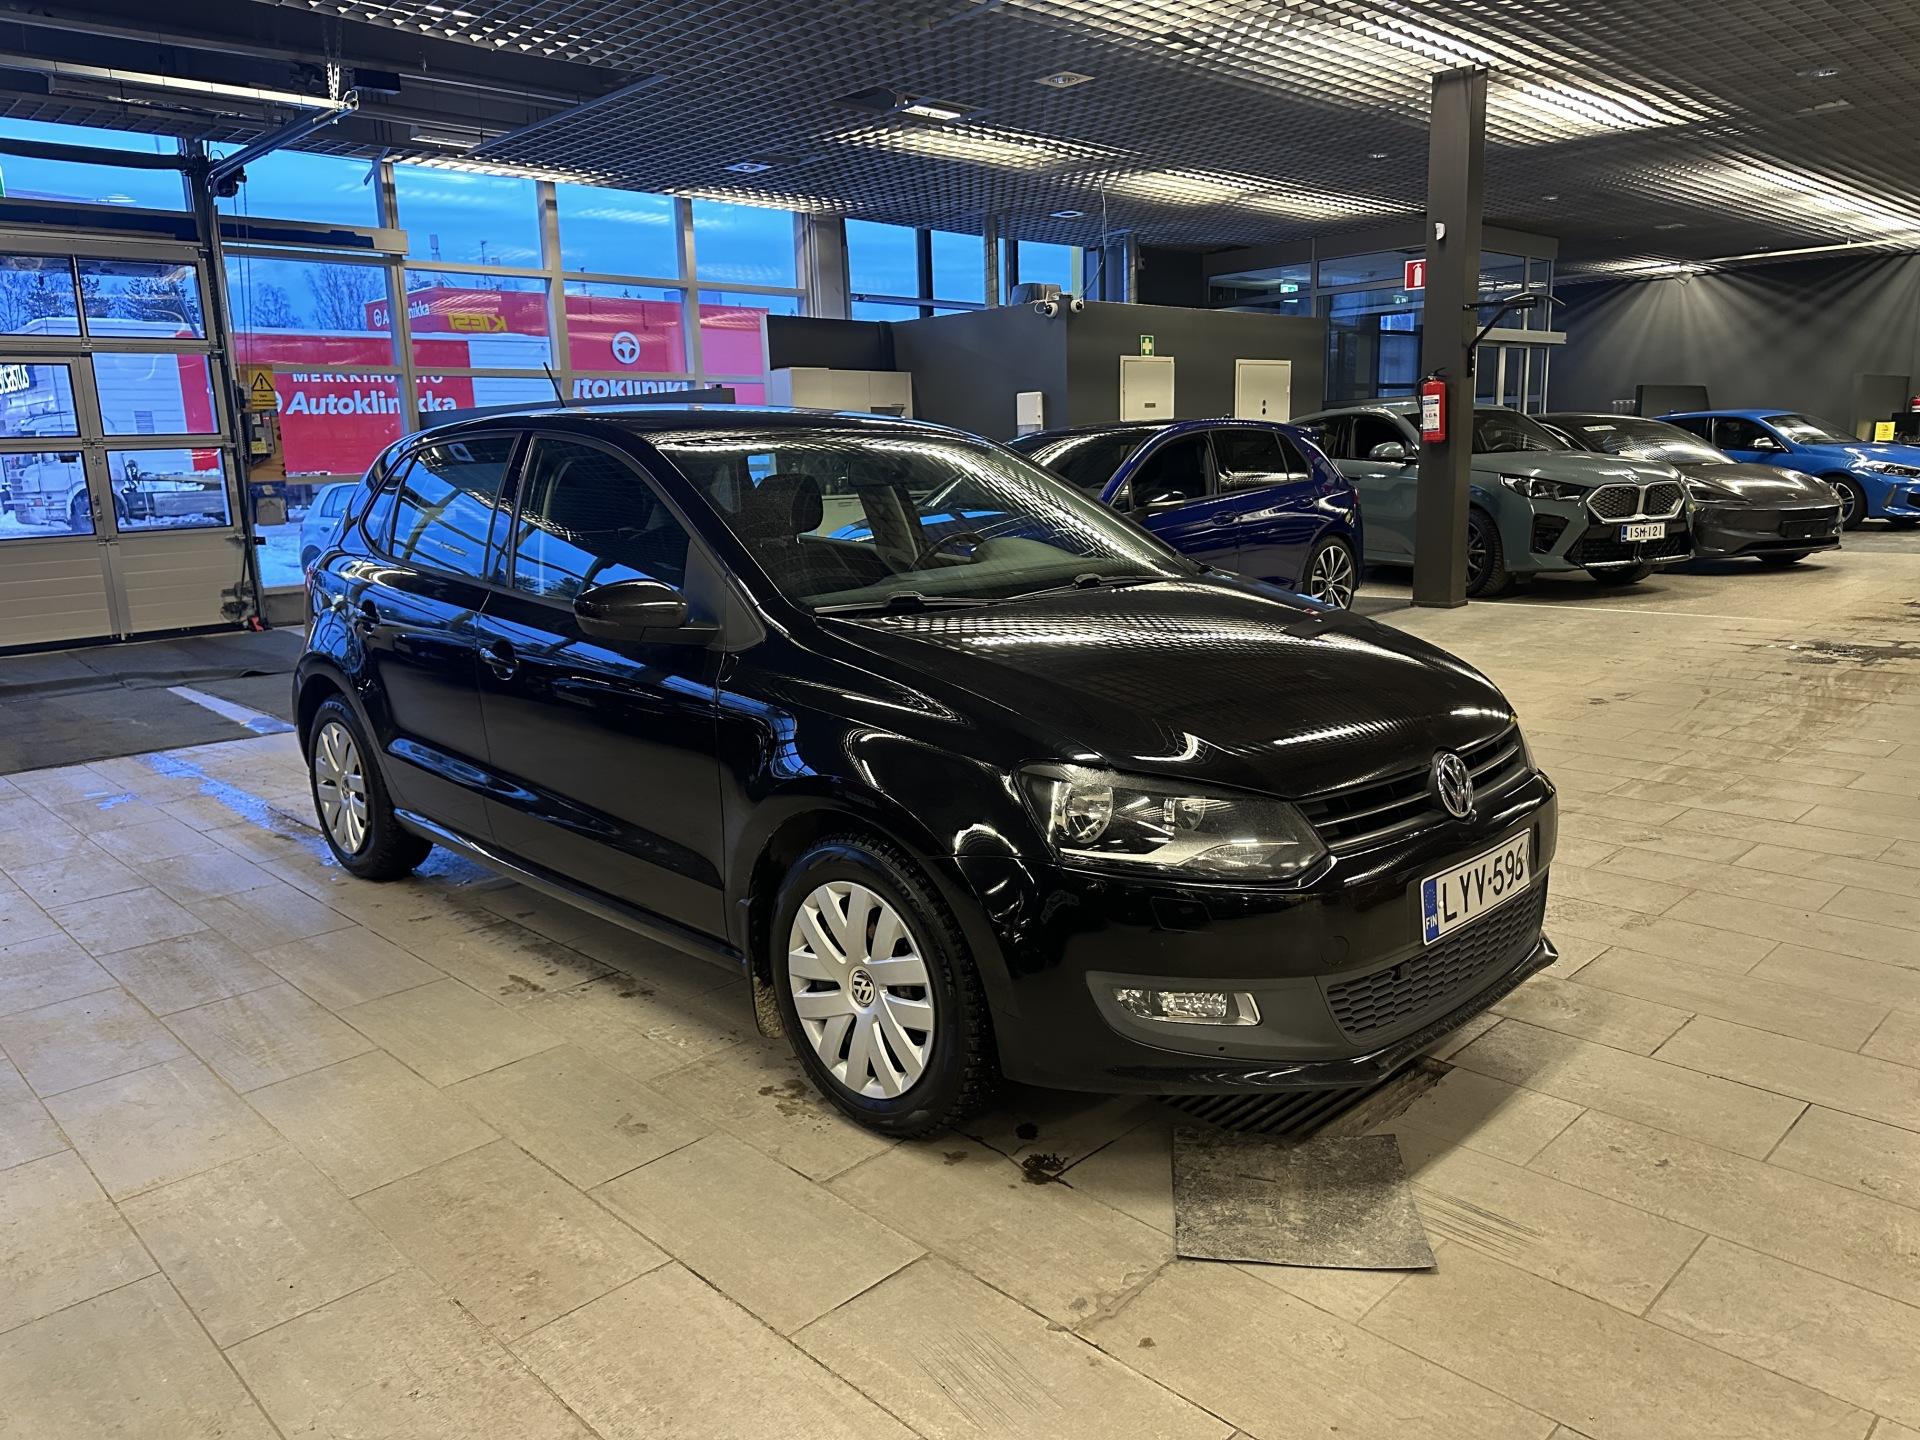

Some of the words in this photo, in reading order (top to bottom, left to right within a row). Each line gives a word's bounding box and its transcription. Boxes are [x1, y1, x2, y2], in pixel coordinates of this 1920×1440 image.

[286, 390, 457, 415] Autoklinka
[1442, 842, 1524, 923] LYV-596
[1425, 913, 1438, 930] FIN
